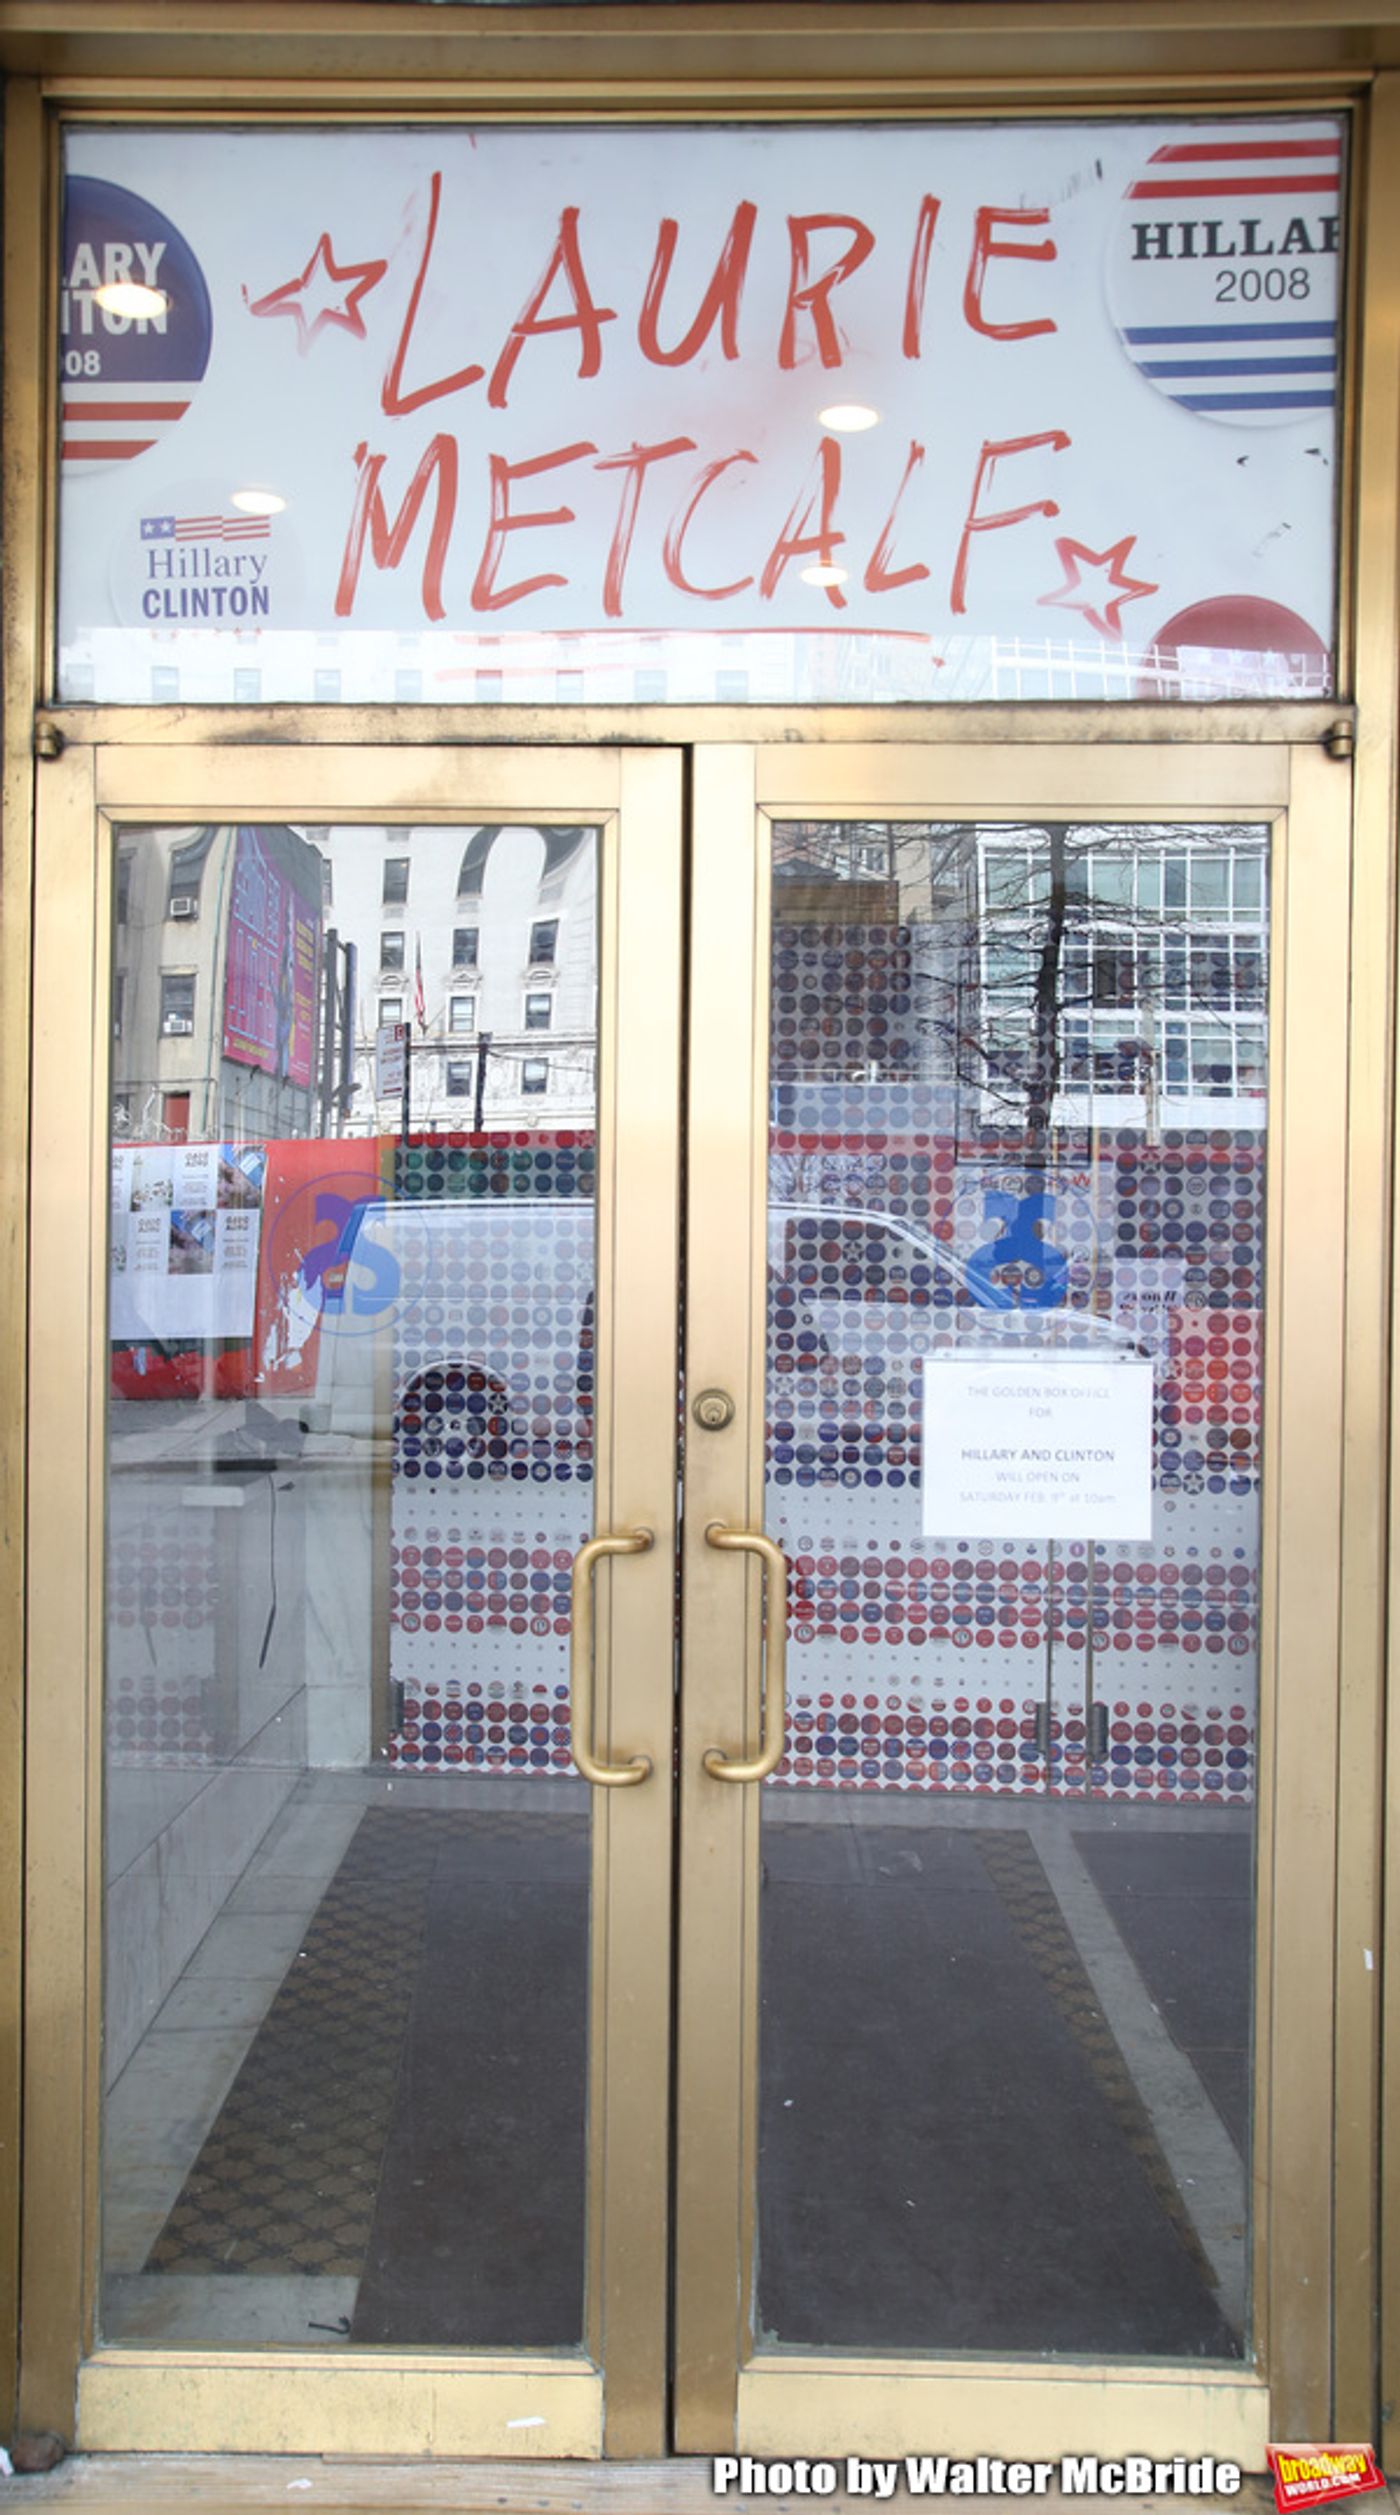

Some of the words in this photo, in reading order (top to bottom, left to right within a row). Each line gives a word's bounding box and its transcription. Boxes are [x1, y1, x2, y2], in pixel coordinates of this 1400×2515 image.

[381, 171, 1058, 416] LAURIE
[1215, 267, 1311, 302] 2008
[333, 429, 1072, 621] METCALF
[147, 547, 268, 584] Hillary
[142, 585, 269, 619] CLINTON
[967, 1385, 989, 1398] THE
[991, 1385, 1041, 1398] GOLDEN
[1043, 1386, 1067, 1399] BOX
[1070, 1387, 1111, 1399] OFFICE
[1028, 1406, 1053, 1419] FOR
[961, 1449, 1018, 1461] HILLARY
[1020, 1449, 1052, 1462] AND
[1054, 1449, 1115, 1462] CLINTON
[995, 1472, 1023, 1483] WILL
[1026, 1472, 1059, 1483] OPEN
[1062, 1472, 1080, 1483] ON
[959, 1491, 1021, 1503] SATURDAY
